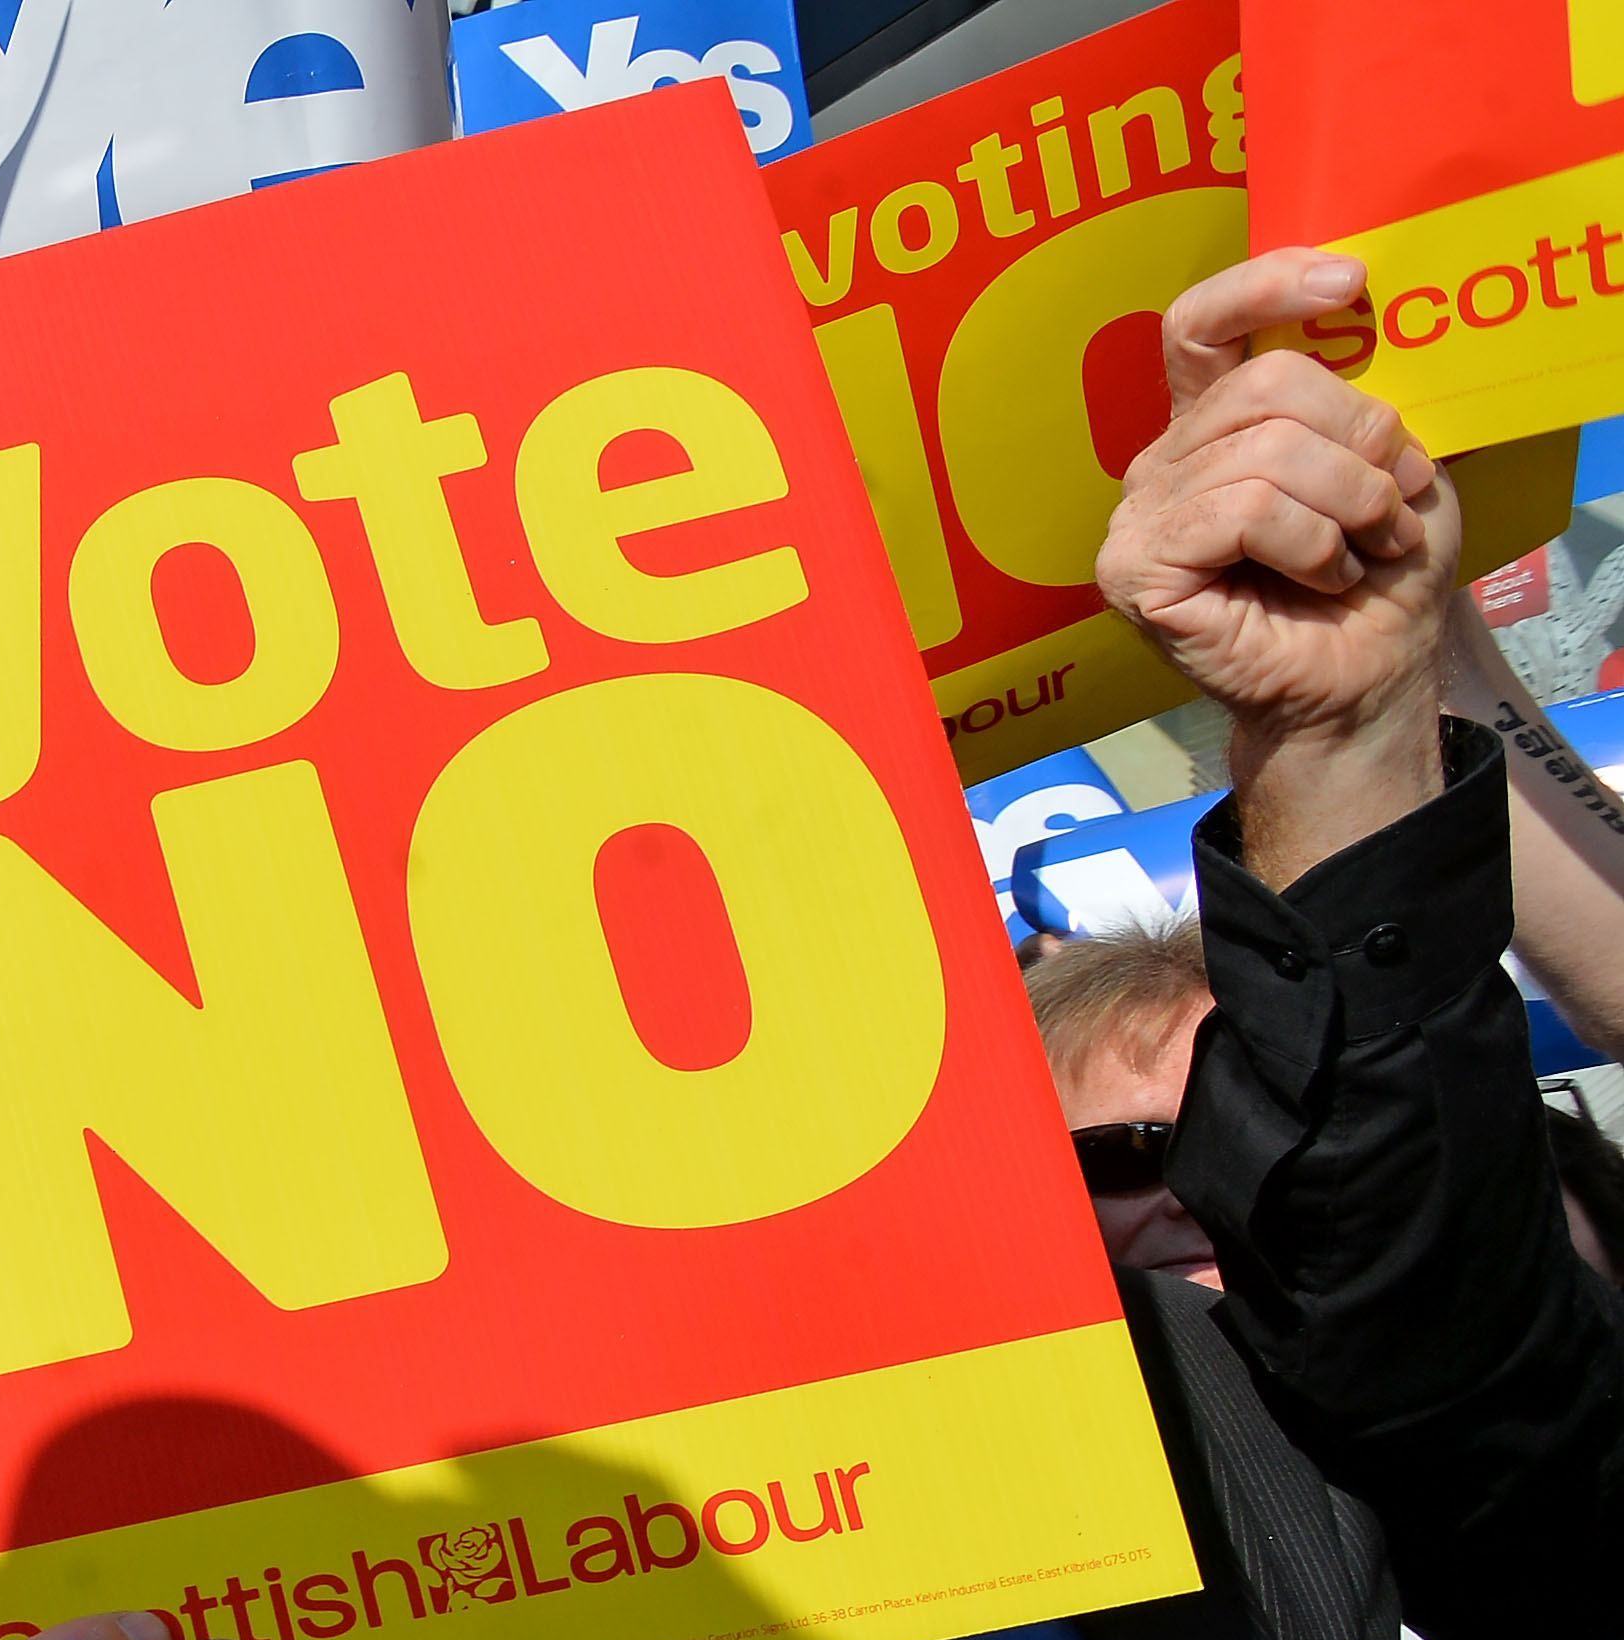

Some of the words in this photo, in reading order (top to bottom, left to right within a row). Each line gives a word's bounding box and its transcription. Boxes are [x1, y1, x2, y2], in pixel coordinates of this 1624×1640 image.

[506, 1461, 872, 1593] Labour
[760, 1620, 790, 1637] Signs
[813, 1608, 847, 1625] 36-38
[848, 1601, 882, 1618] Carron
[915, 1588, 946, 1606] Kelvin
[948, 1578, 998, 1598] Industrial
[1037, 1566, 1062, 1581] East
[1063, 1557, 1102, 1576] Kilbride
[1103, 1552, 1127, 1569] G75
